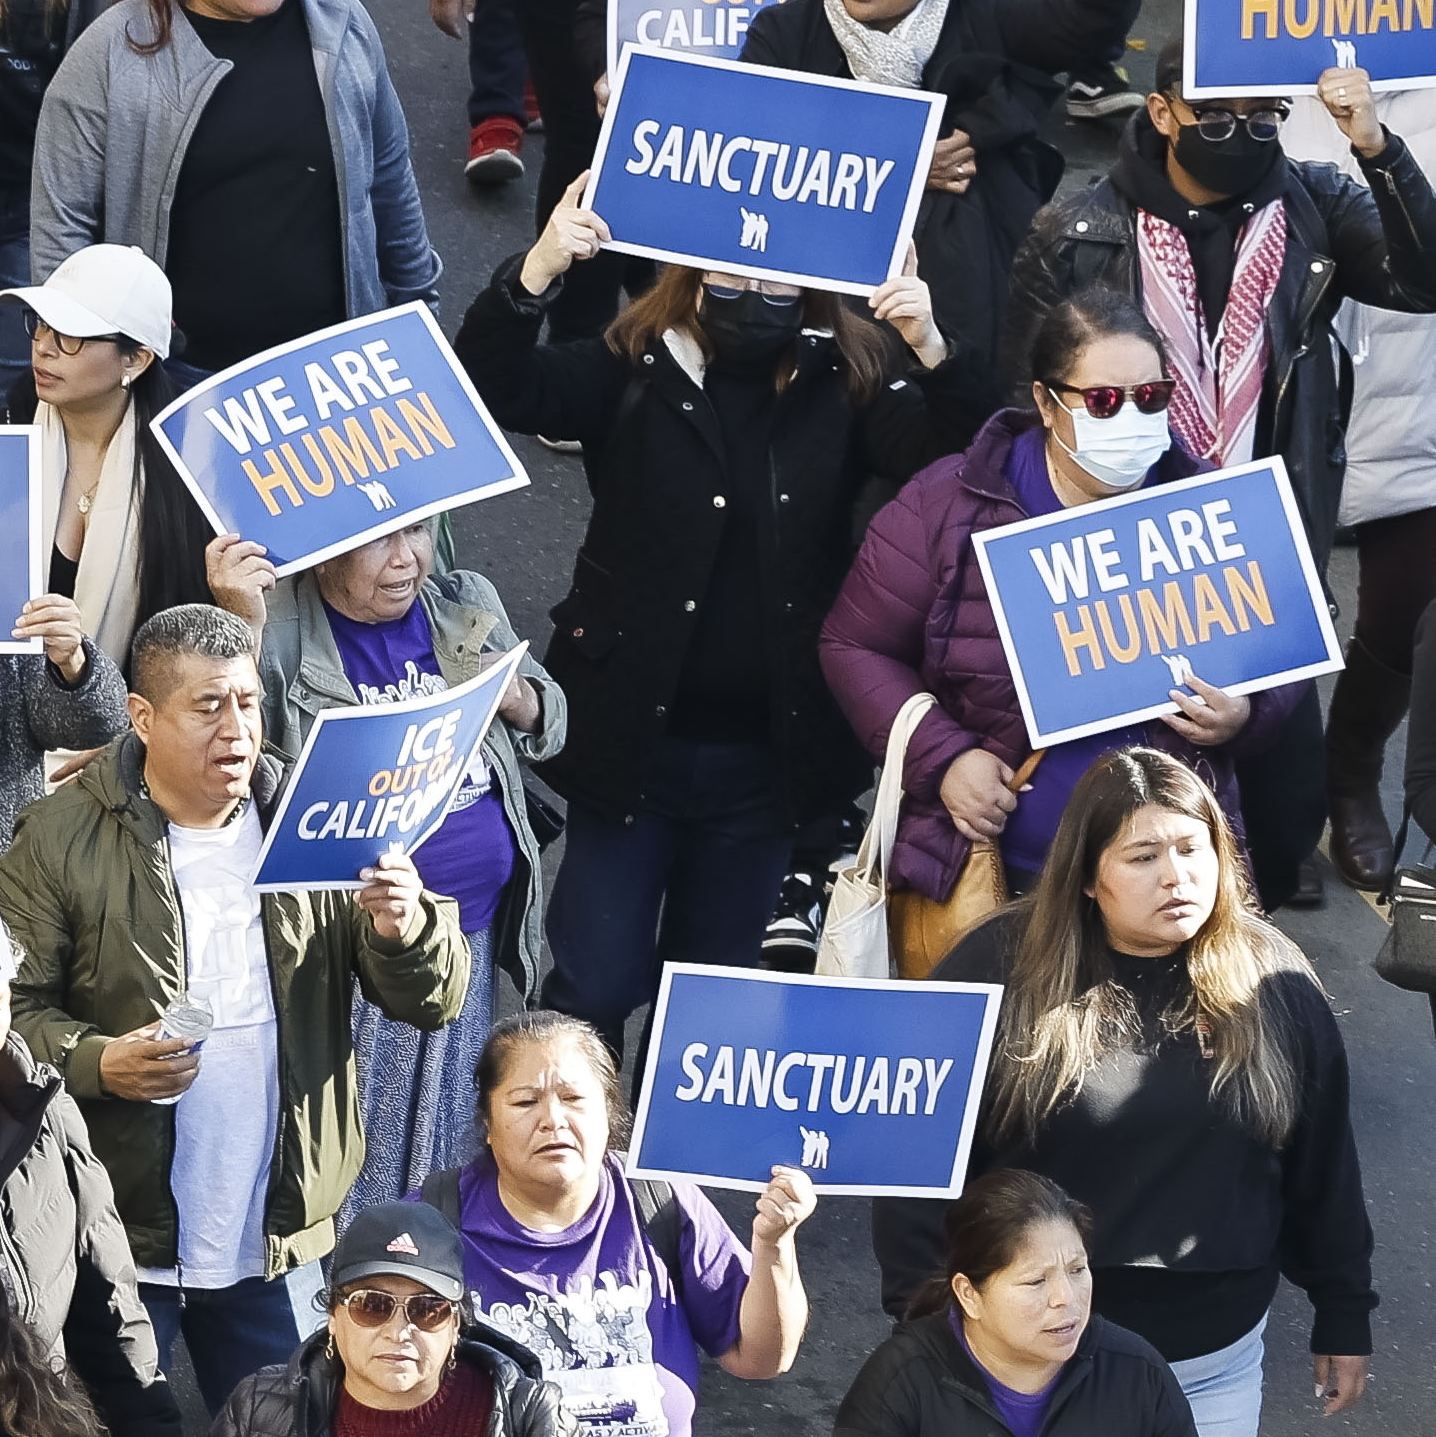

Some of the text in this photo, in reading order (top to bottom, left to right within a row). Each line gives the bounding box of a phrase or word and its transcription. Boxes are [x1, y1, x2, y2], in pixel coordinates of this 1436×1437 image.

[636, 7, 757, 47] CALIF
[626, 120, 895, 214] SANCTUARY
[204, 340, 414, 456] WE ARE
[241, 391, 457, 517] HUMAN
[1030, 499, 1246, 604] WE ARE
[1053, 560, 1276, 677] HUMAN
[369, 764, 428, 796] OUT
[397, 709, 463, 766] ICE
[676, 1041, 954, 1116] SANCTUARY
